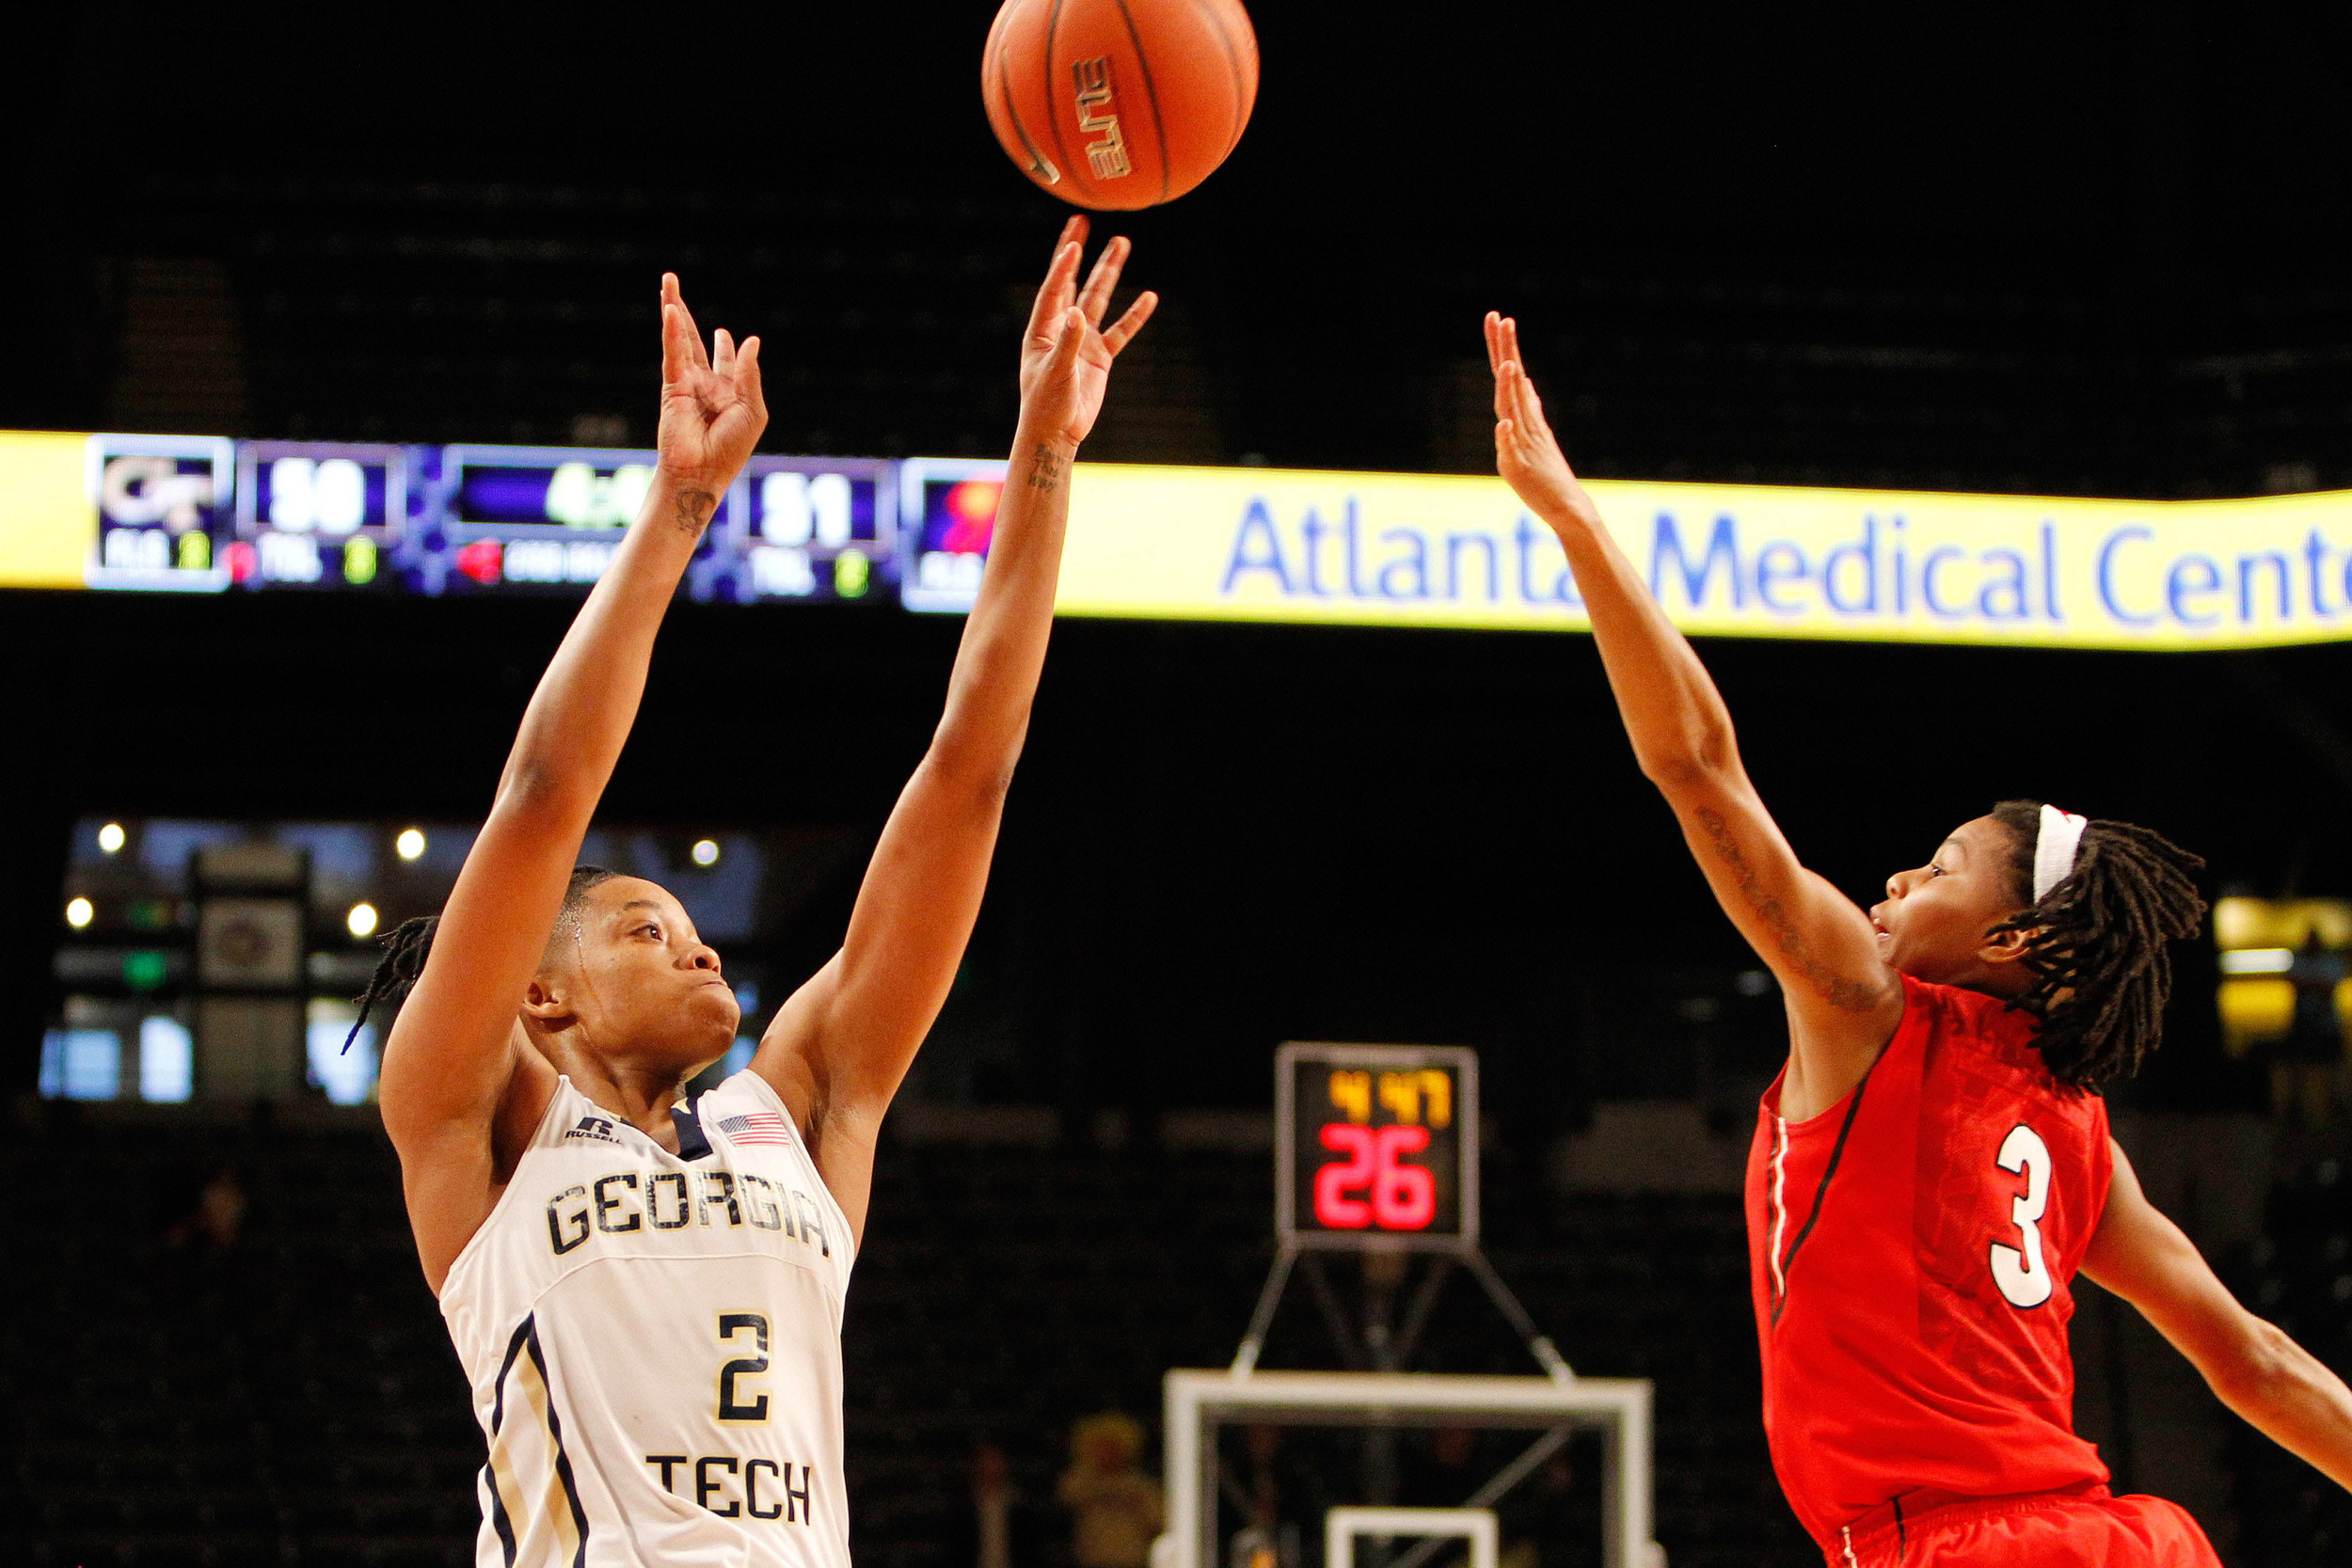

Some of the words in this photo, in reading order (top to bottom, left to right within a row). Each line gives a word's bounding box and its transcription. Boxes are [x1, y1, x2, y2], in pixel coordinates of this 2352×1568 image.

[1071, 55, 1132, 180] ELITE
[1651, 511, 2065, 621] Medical
[2095, 524, 2352, 627] Cent
[564, 1130, 624, 1146] RUSSELL
[1314, 1123, 1436, 1229] 26
[547, 1169, 830, 1258] GEORGIA
[1990, 1122, 2053, 1309] 3
[716, 1311, 772, 1424] 2
[645, 1455, 811, 1528] TECH
